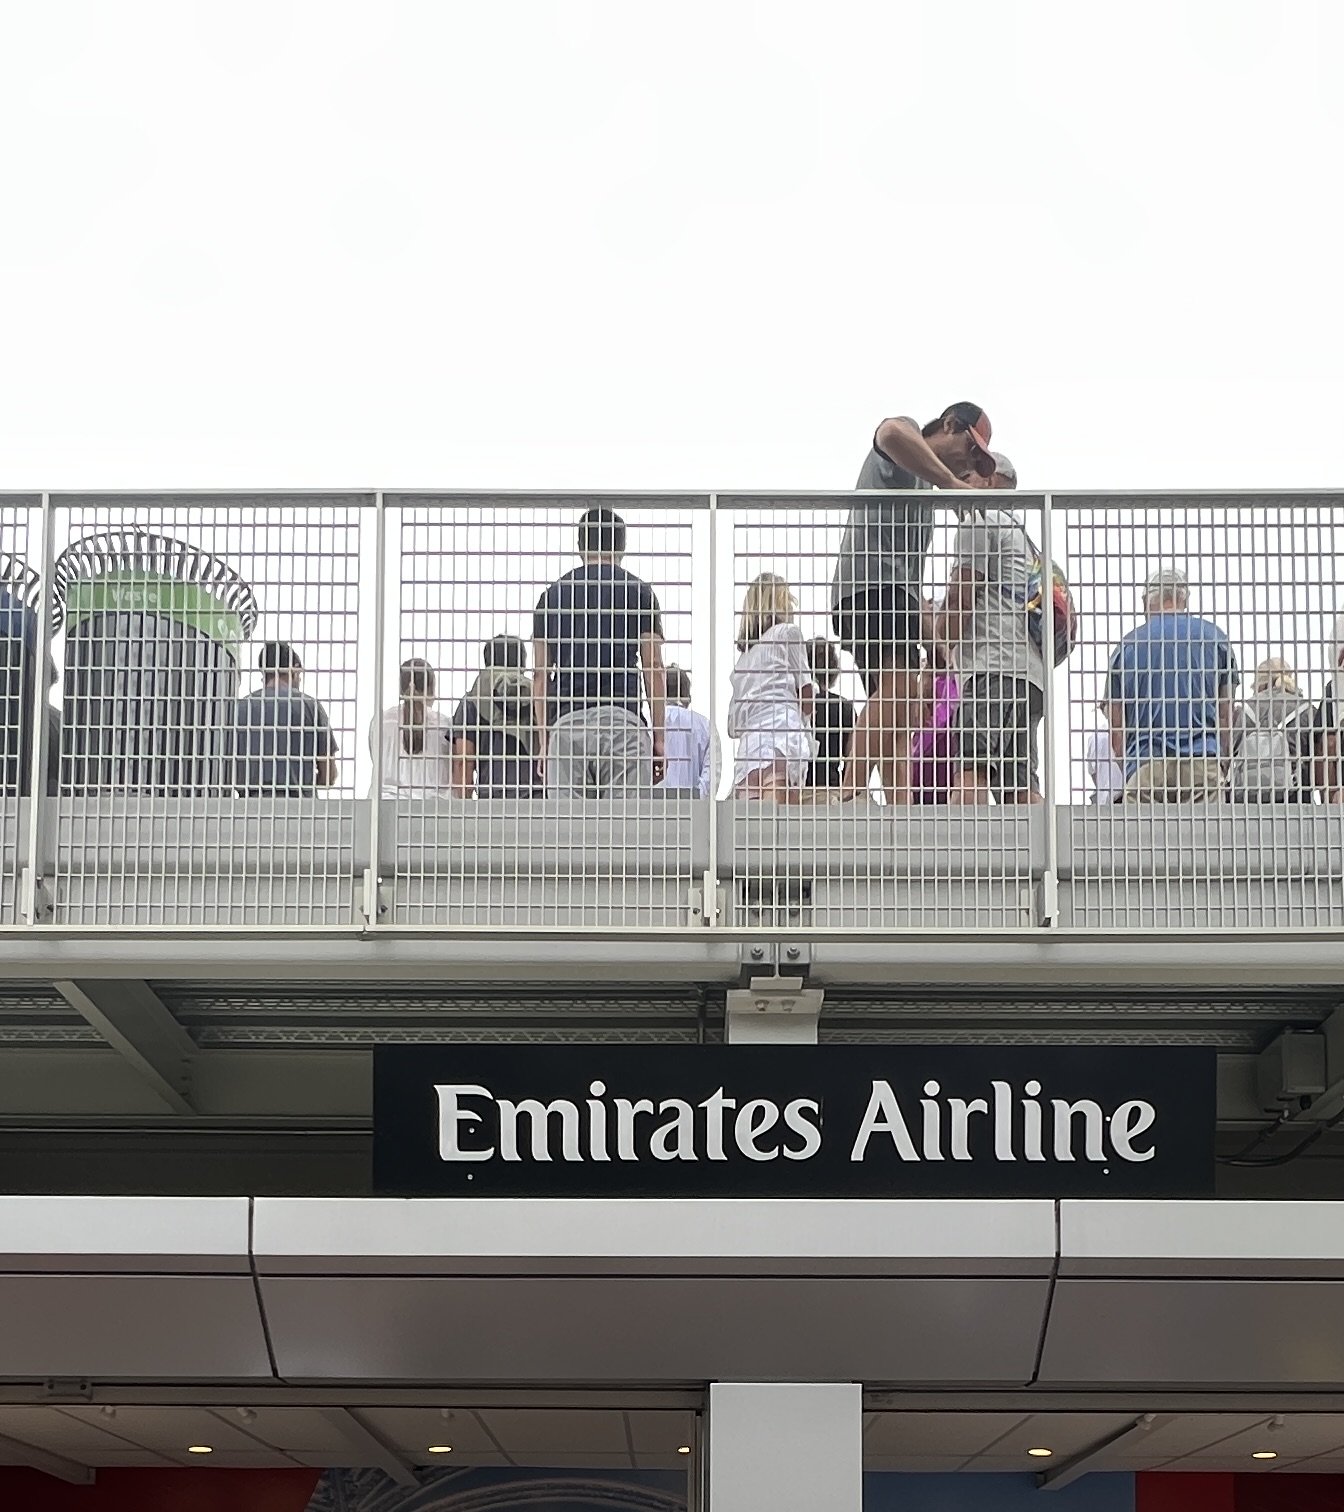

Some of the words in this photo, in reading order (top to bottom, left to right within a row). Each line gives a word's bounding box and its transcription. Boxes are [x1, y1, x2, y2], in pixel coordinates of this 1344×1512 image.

[112, 588, 158, 604] Wase
[433, 1080, 822, 1162] Emirates
[851, 1080, 1158, 1162] Airline
